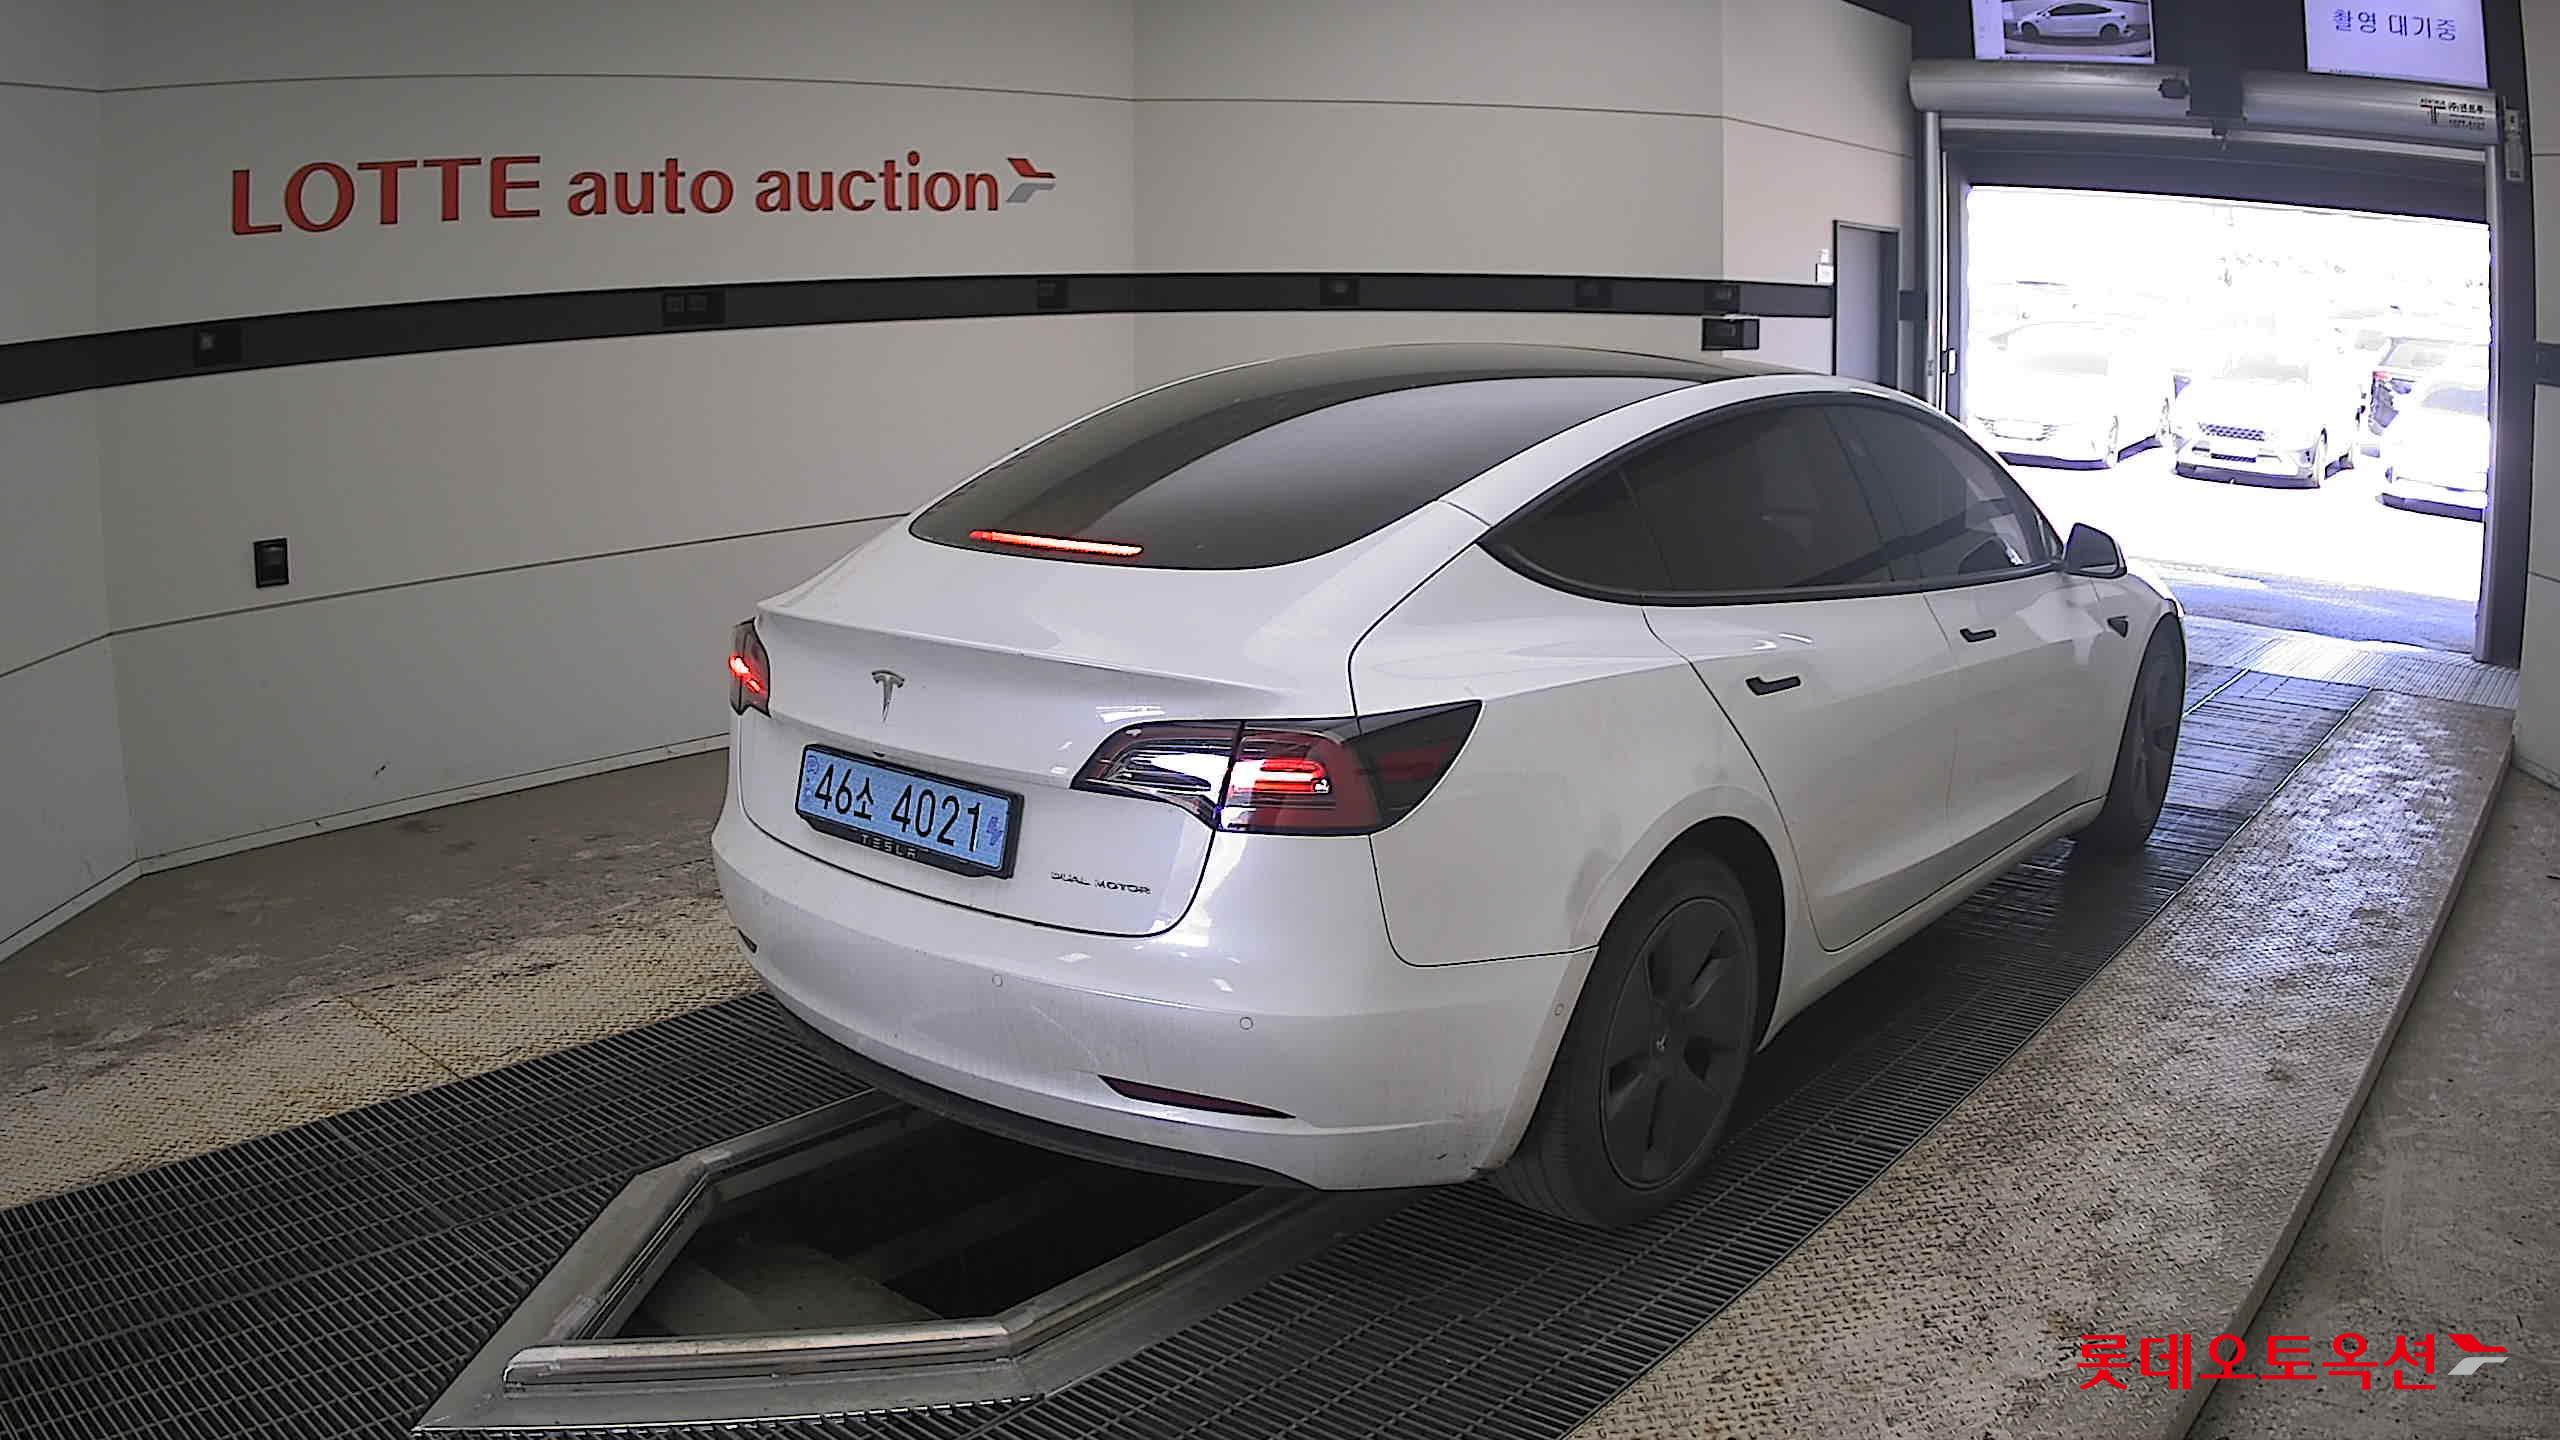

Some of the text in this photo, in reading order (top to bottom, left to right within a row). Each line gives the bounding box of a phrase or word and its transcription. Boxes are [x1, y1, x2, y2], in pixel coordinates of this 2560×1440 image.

[2388, 13, 2457, 42] 대기중
[231, 151, 999, 235] LOTTE auto auction
[814, 763, 982, 852] 46소 4021
[861, 833, 919, 860] TESLA
[1094, 879, 1152, 895] MOTOR
